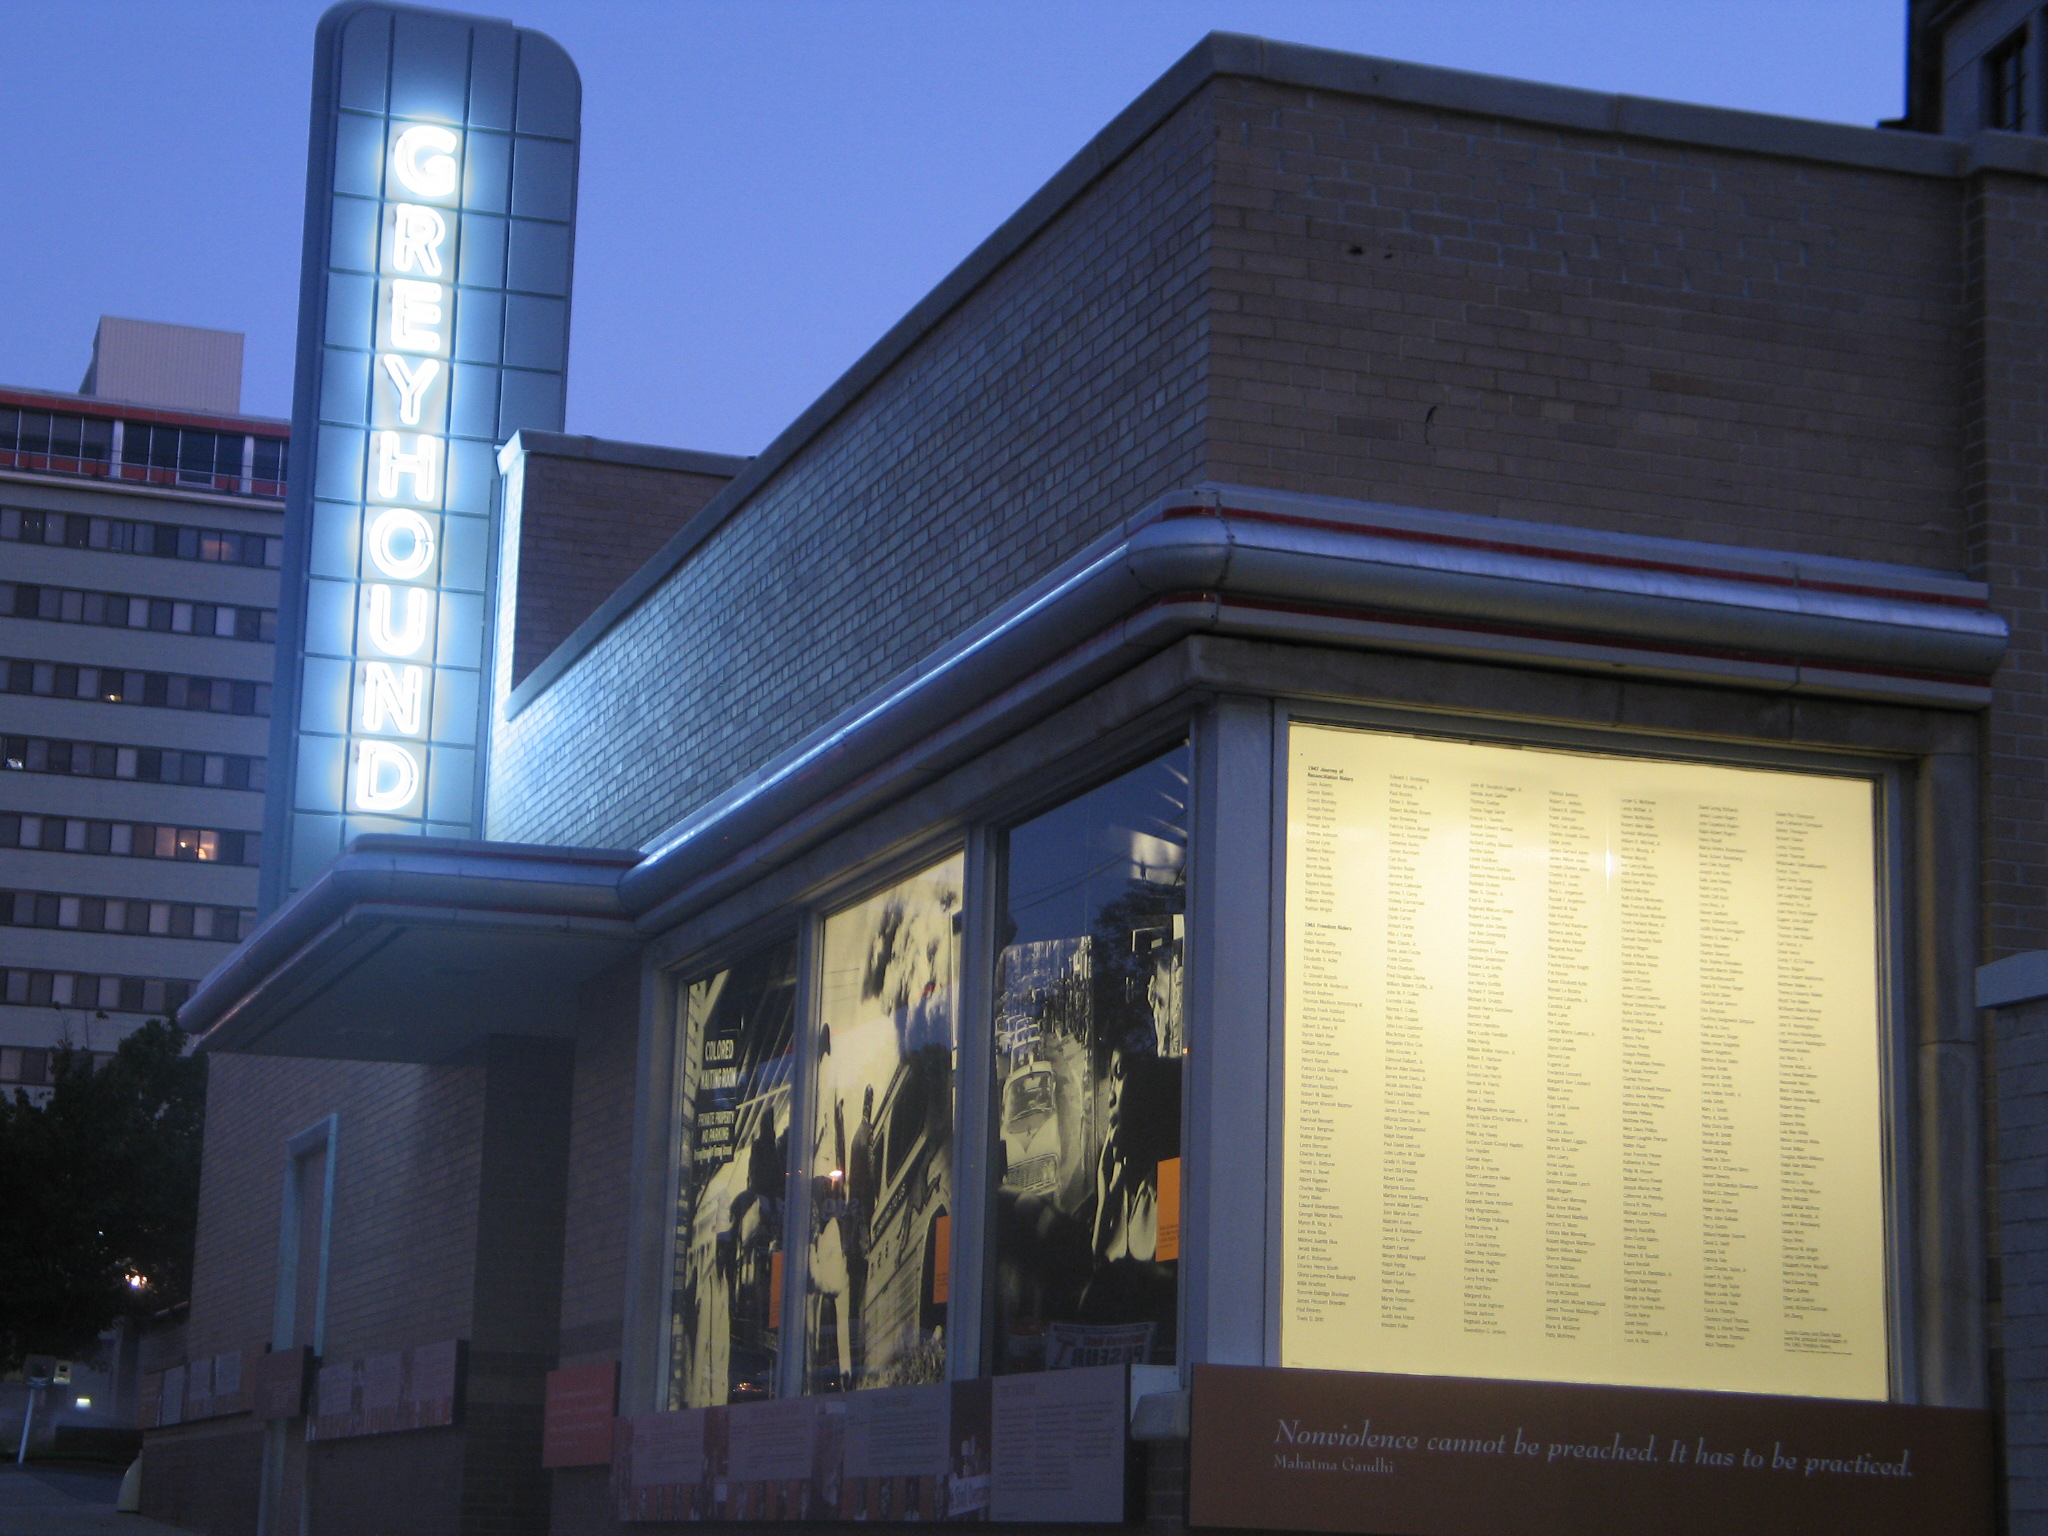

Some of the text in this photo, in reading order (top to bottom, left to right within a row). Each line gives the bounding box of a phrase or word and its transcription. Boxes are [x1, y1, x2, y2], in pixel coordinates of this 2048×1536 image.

[353, 124, 458, 811] GREYHOUND
[705, 1039, 734, 1061] COLORED
[1273, 1419, 1914, 1477] Nonviolence cannot be preached. It has to be practiced.
[1273, 1453, 1394, 1473] Mahatma Gandhi
